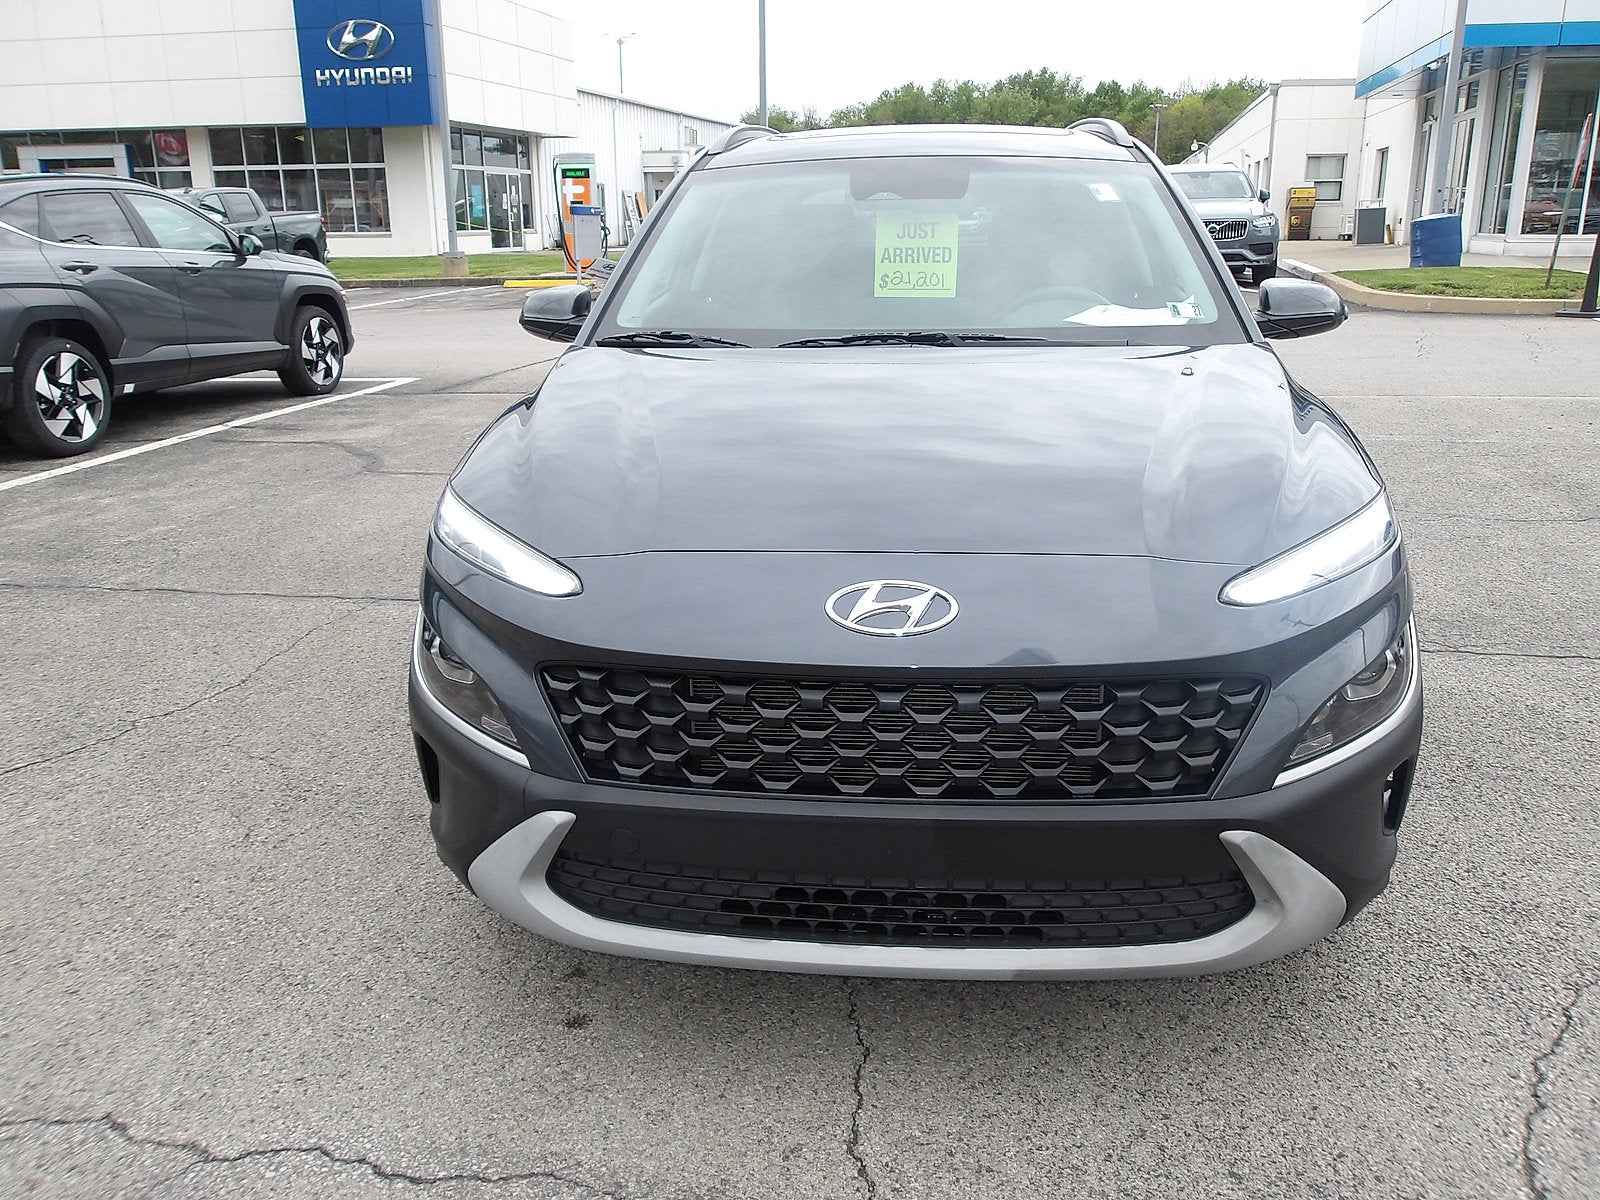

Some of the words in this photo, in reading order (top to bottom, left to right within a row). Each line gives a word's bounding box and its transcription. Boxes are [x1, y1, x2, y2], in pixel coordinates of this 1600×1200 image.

[315, 66, 413, 87] HYUNDAI
[896, 221, 938, 239] JUST
[880, 246, 952, 264] ARRIVED
